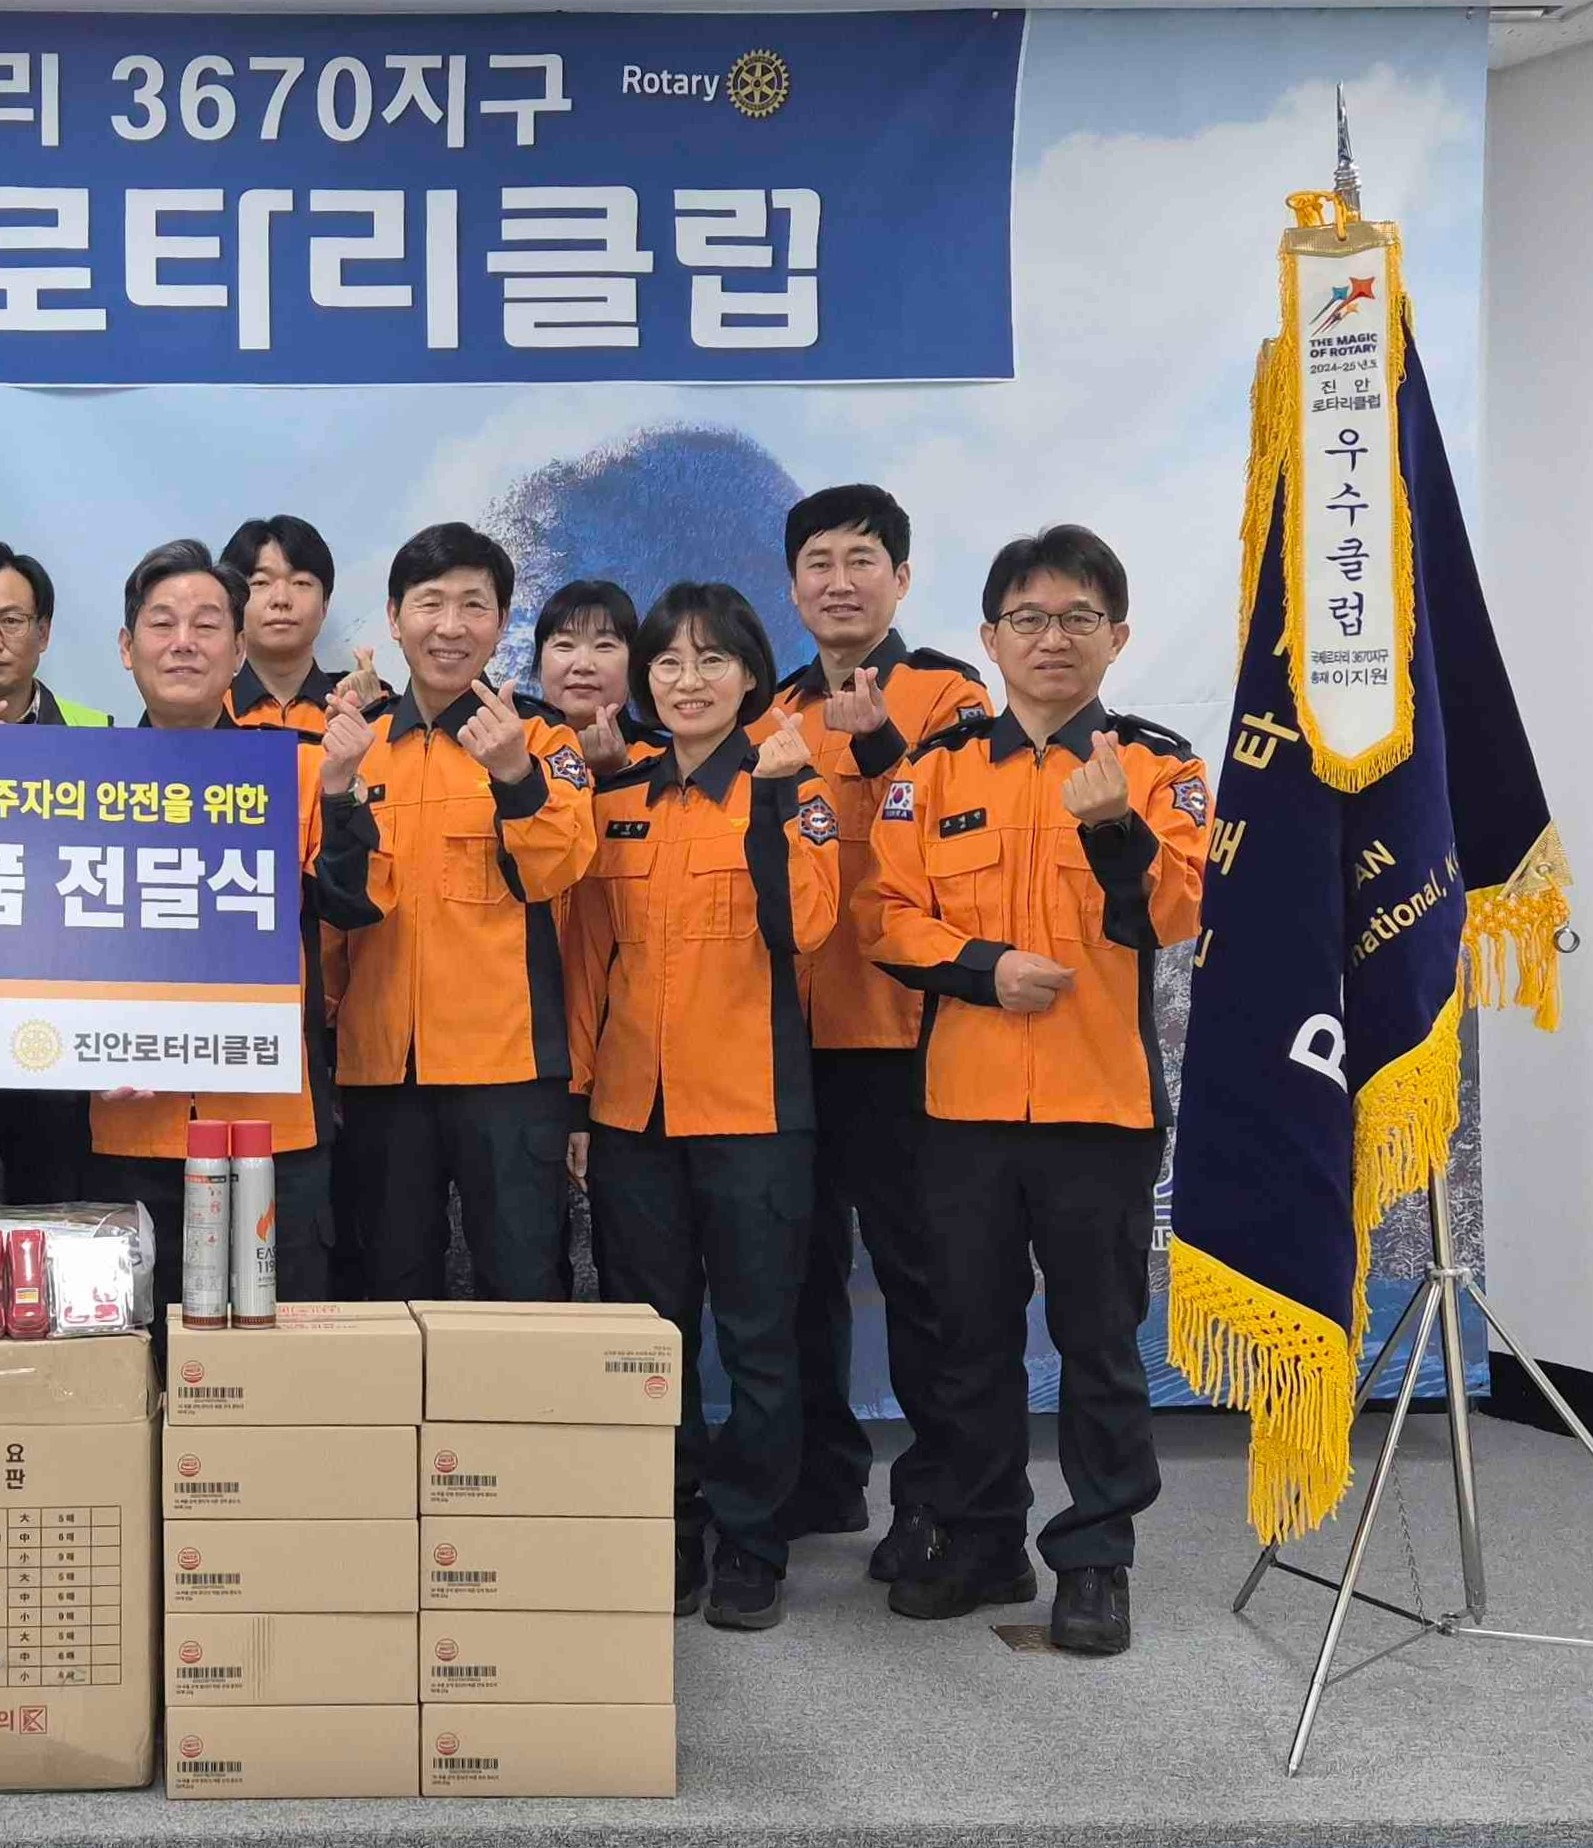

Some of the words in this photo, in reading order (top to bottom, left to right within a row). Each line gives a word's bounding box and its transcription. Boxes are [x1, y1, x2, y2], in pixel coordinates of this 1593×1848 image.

[622, 65, 720, 101] Rotary
[110, 52, 573, 149] 3670지구
[1309, 338, 1333, 348] THE
[1336, 333, 1378, 346] MAGIC
[1310, 348, 1328, 359] OF
[1330, 344, 1377, 357] ROTARY
[1311, 394, 1381, 412] 로타리클럽
[1332, 667, 1388, 686] 이지원
[96, 781, 193, 824] 안전을
[203, 783, 268, 825] 위한
[55, 846, 277, 931] 전달식
[74, 1031, 281, 1067] 진안로터리클럽
[19, 1513, 30, 1523] 大
[19, 1533, 30, 1543] 中
[19, 1552, 30, 1563] 小
[19, 1573, 30, 1582] 大
[19, 1593, 30, 1602] 中
[19, 1612, 30, 1622] 小
[19, 1632, 30, 1642] 大
[19, 1652, 30, 1661] 中
[19, 1671, 30, 1682] 小
